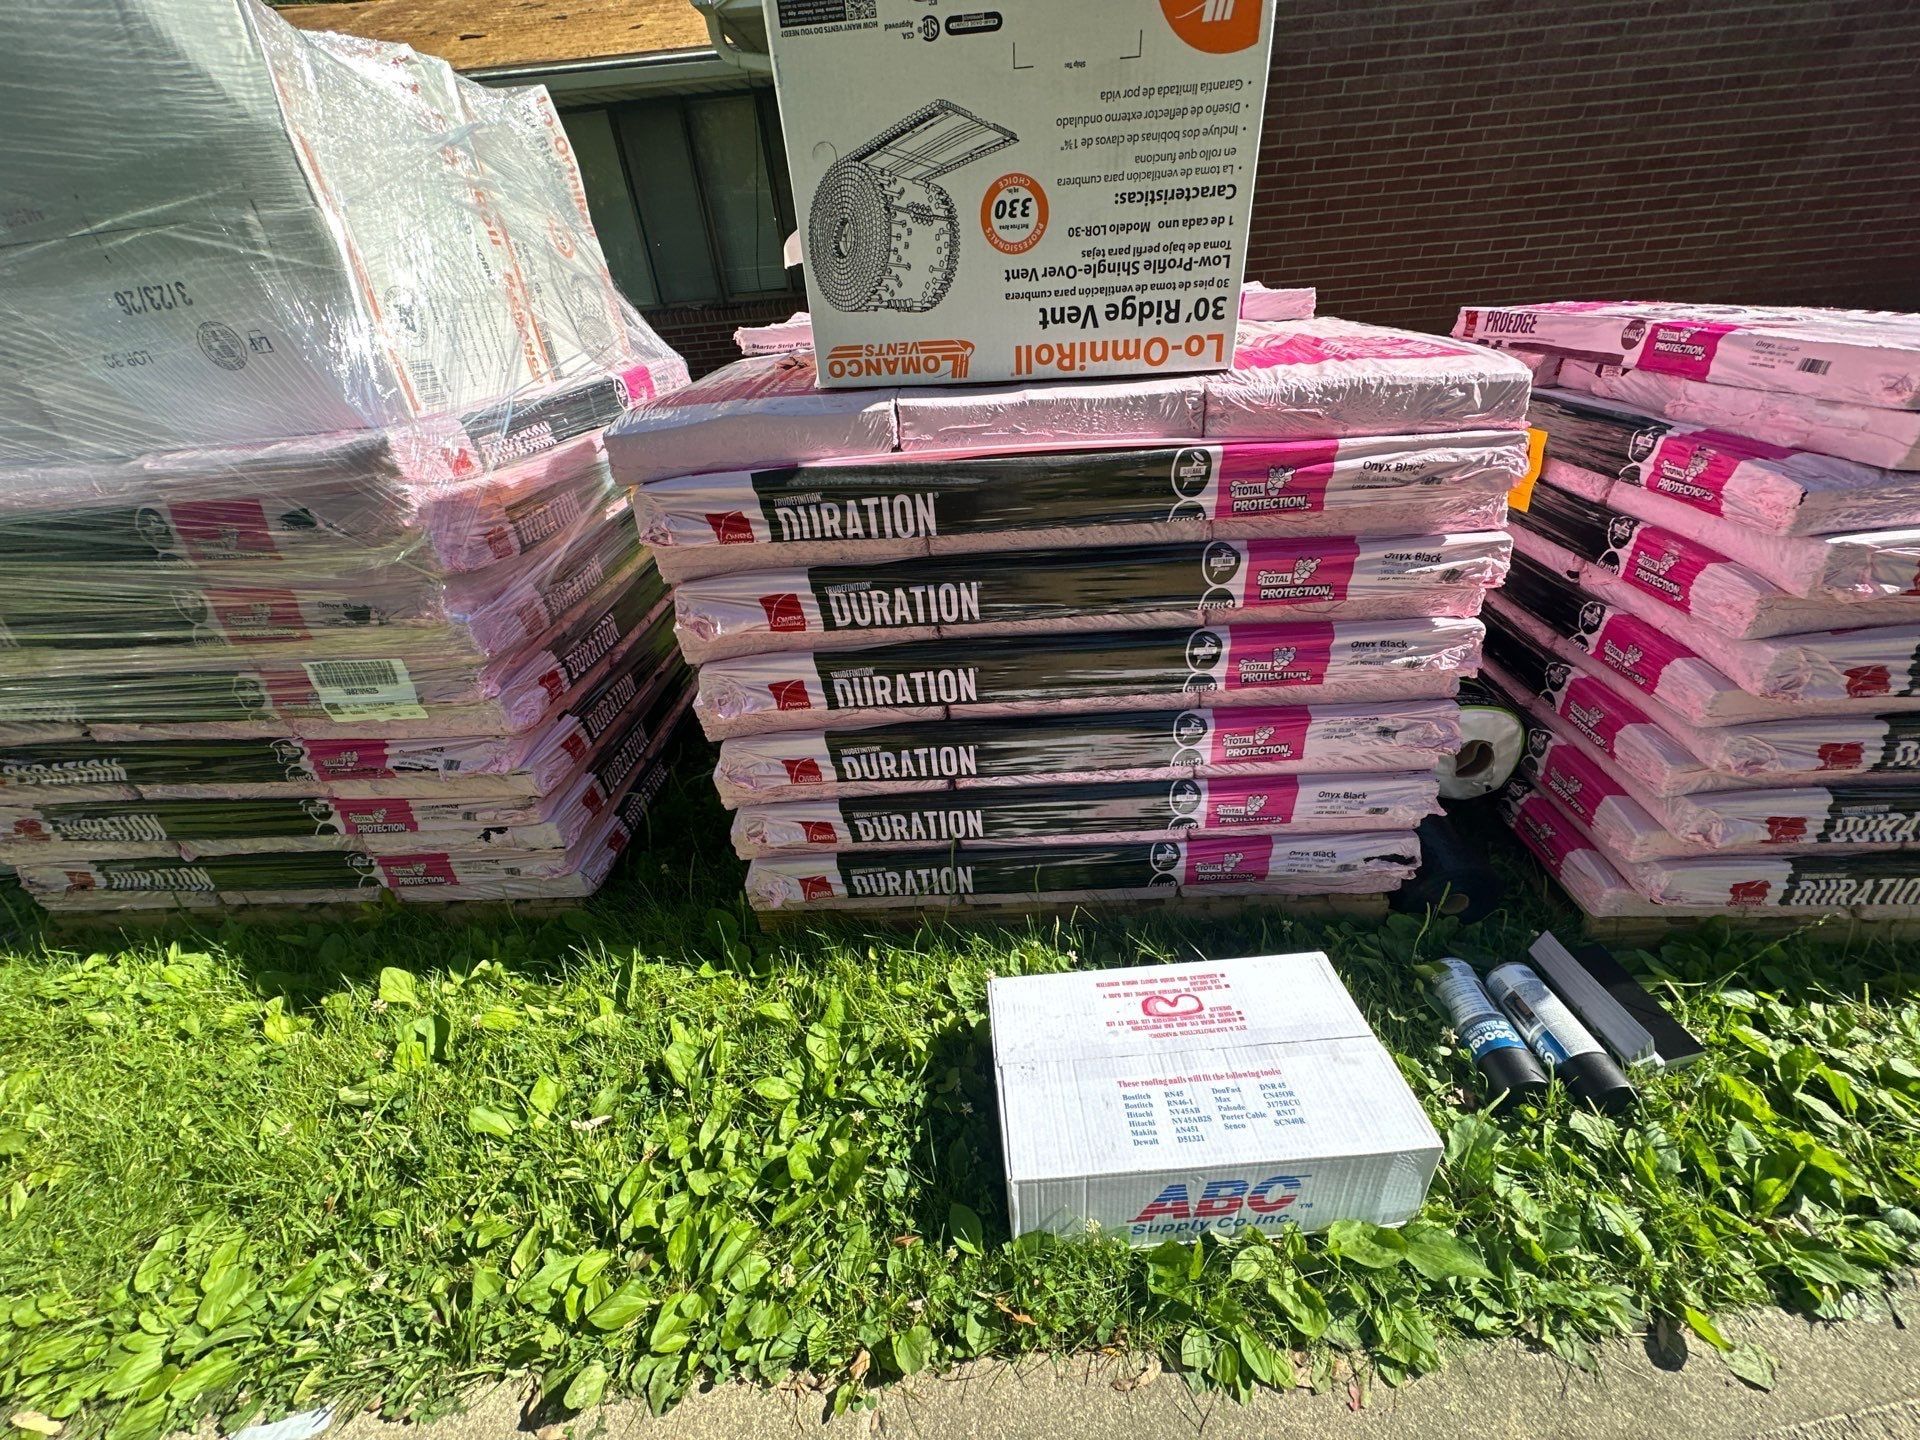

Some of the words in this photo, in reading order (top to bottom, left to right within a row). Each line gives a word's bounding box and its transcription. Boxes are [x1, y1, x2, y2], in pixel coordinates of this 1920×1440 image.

[824, 24, 843, 33] VENTS
[842, 22, 862, 31] MANY
[861, 20, 878, 29] HOW
[884, 20, 914, 31] Approved
[801, 28, 814, 36] YOU
[902, 32, 915, 40] CSA
[1157, 83, 1198, 95] limitada
[1200, 79, 1243, 90] Garantía
[1100, 91, 1120, 102] vida
[1124, 86, 1140, 97] por
[1143, 86, 1155, 96] de
[1144, 106, 1189, 119] deflector
[1191, 105, 1203, 114] de
[1206, 102, 1240, 114] Diseño
[1056, 115, 1102, 128] ondulado
[1105, 111, 1142, 122] externo
[1142, 130, 1180, 141] bobinas
[1182, 128, 1200, 137] dos
[1203, 124, 1238, 137] Incluye
[1081, 136, 1093, 146] de
[1095, 134, 1125, 145] clavos
[1127, 133, 1140, 142] de
[1134, 151, 1176, 164] funciona
[1179, 150, 1197, 159] que
[1200, 148, 1221, 158] rollo
[1224, 147, 1236, 156] en
[1181, 168, 1193, 176] de
[1195, 165, 1220, 175] toma
[1222, 164, 1234, 174] La
[1057, 174, 1102, 186] cumbrera
[1104, 172, 1125, 182] para
[1126, 169, 1179, 182] ventilación
[998, 176, 1031, 188] CHOICE
[995, 198, 1032, 219] 330
[1109, 221, 1151, 232] Modelo
[1158, 220, 1179, 229] uno
[1182, 218, 1209, 228] cada
[1211, 217, 1226, 226] de
[1229, 216, 1234, 225] 1
[986, 222, 1044, 251] PROFESSIONAL'S
[1068, 225, 1108, 237] LOR-30
[1108, 246, 1131, 256] para
[1133, 244, 1161, 254] perfil
[1162, 242, 1186, 253] bajo
[1188, 242, 1201, 251] de
[1203, 240, 1232, 250] Toma
[1081, 247, 1107, 258] tejas
[1041, 259, 1140, 278] Shingle-Over
[1144, 255, 1231, 272] Low-Profile
[1005, 268, 1039, 282] Vent
[1135, 284, 1148, 293] de
[1151, 282, 1177, 292] toma
[1179, 281, 1191, 290] de
[1193, 278, 1214, 290] pies
[1216, 278, 1230, 288] 30
[1005, 289, 1052, 301] cumbrera
[1054, 287, 1077, 297] para
[1078, 286, 1134, 298] ventilación
[114, 281, 193, 316] 3/23/26
[1104, 295, 1182, 324] Ridge
[1185, 295, 1228, 324] 30'
[1038, 303, 1100, 330] Vent
[1484, 311, 1538, 333] PROEDGE
[1623, 327, 1637, 339] CLASS
[1636, 325, 1645, 341] 3
[1660, 332, 1679, 340] TOTAL
[864, 340, 919, 356] VENTS
[1015, 332, 1225, 376] Lo-OmniRoll
[1654, 342, 1704, 355] PROTECTION
[828, 354, 969, 379] LOMANCO
[1363, 461, 1391, 472] Onyx
[1237, 485, 1264, 496] TOTAL
[773, 492, 822, 507] TRUDEFINITION
[1233, 496, 1306, 512] PROTECTION
[775, 492, 937, 541] DURATION
[1415, 553, 1441, 562] Black
[1264, 575, 1289, 583] TOTAL
[1635, 567, 1681, 595] PROTECTION
[825, 582, 872, 594] TRUDEFINITION
[1260, 585, 1330, 599] PROTECTION
[828, 581, 981, 627] DURATION
[1380, 640, 1407, 648] Black
[1607, 645, 1623, 661] TOTAL
[1241, 671, 1308, 683] PROTECTION
[833, 667, 978, 708] DURATION
[587, 672, 636, 739] DURATION
[1228, 737, 1252, 745] TOTAL
[1226, 745, 1289, 757] PROTECTION
[602, 723, 650, 794] DURATION
[841, 746, 977, 780] DURATION
[357, 823, 405, 833] PROTECTION
[854, 810, 984, 842] DURATION
[110, 867, 215, 891] DURATION
[399, 876, 445, 885] PROTECTION
[852, 866, 974, 896] DURATION
[1198, 873, 1252, 881] PROTECTION
[1469, 1030, 1519, 1055] Geocel
[1117, 1080, 1140, 1089] These
[1141, 1078, 1168, 1088] roofing
[1212, 1073, 1225, 1081] the
[1226, 1070, 1261, 1080] following
[1261, 1068, 1282, 1076] tools:
[1122, 1093, 1151, 1101] Bostitch
[1259, 1083, 1278, 1091] DNR
[1279, 1082, 1287, 1090] 45
[1124, 1102, 1154, 1110] Bostitch
[1167, 1099, 1193, 1107] RN46-1
[1126, 1111, 1153, 1119] Hitachi
[1169, 1107, 1201, 1116] NV45AB
[1266, 1099, 1300, 1109] 3175RCU
[1129, 1120, 1156, 1128] Hitachi
[1221, 1113, 1245, 1121] Porter
[1246, 1111, 1268, 1119] Cable
[1276, 1109, 1297, 1117] RN17
[1131, 1129, 1158, 1137] Makita
[1175, 1126, 1199, 1134] AN451
[1224, 1122, 1247, 1130] Senco
[1274, 1117, 1306, 1127] SCN40R
[1133, 1138, 1160, 1146] Dewalt
[1177, 1135, 1205, 1144] D51321
[1126, 1175, 1312, 1223] ABC
[1131, 1220, 1210, 1235] Supply
